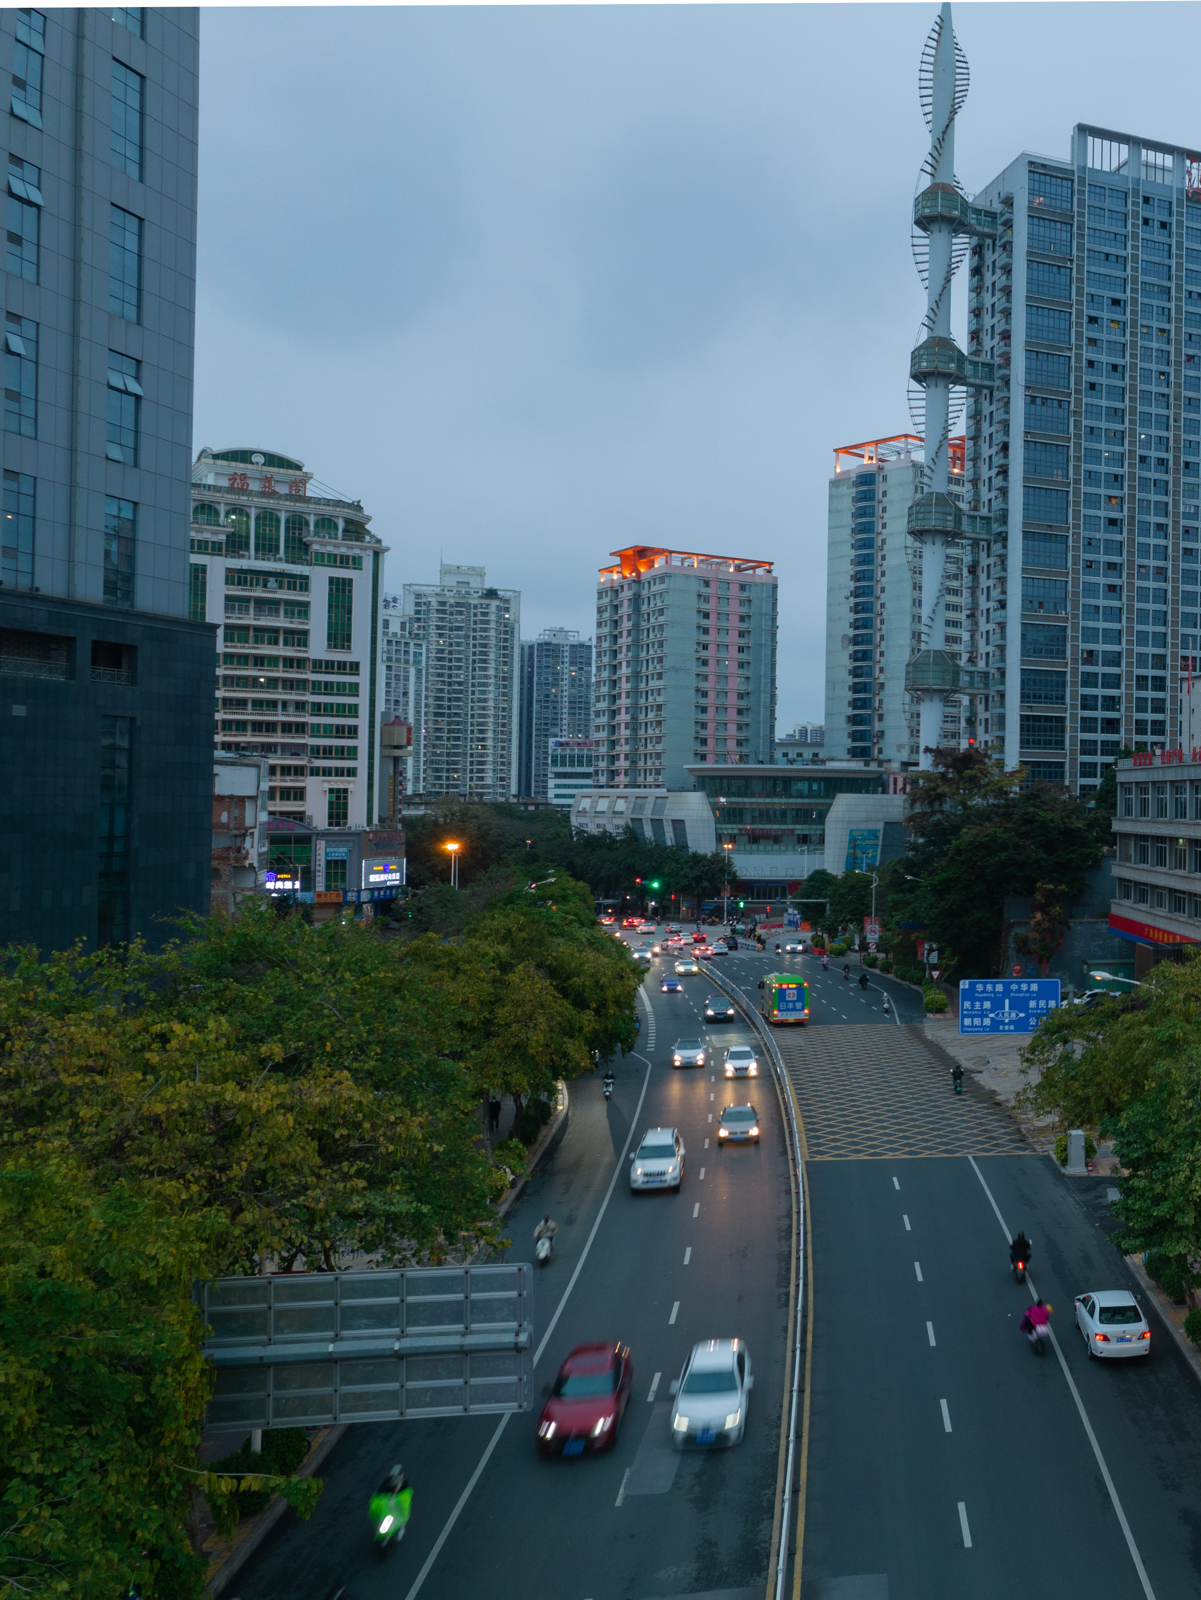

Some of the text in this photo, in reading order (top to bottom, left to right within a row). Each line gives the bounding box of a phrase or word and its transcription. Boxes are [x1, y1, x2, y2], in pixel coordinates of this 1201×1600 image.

[975, 983, 1004, 992] 华东路
[1010, 983, 1039, 992] 中华路
[963, 1001, 992, 1010] 民主路
[1028, 1000, 1057, 1009] 新民路
[963, 1017, 992, 1026] 朝阳路
